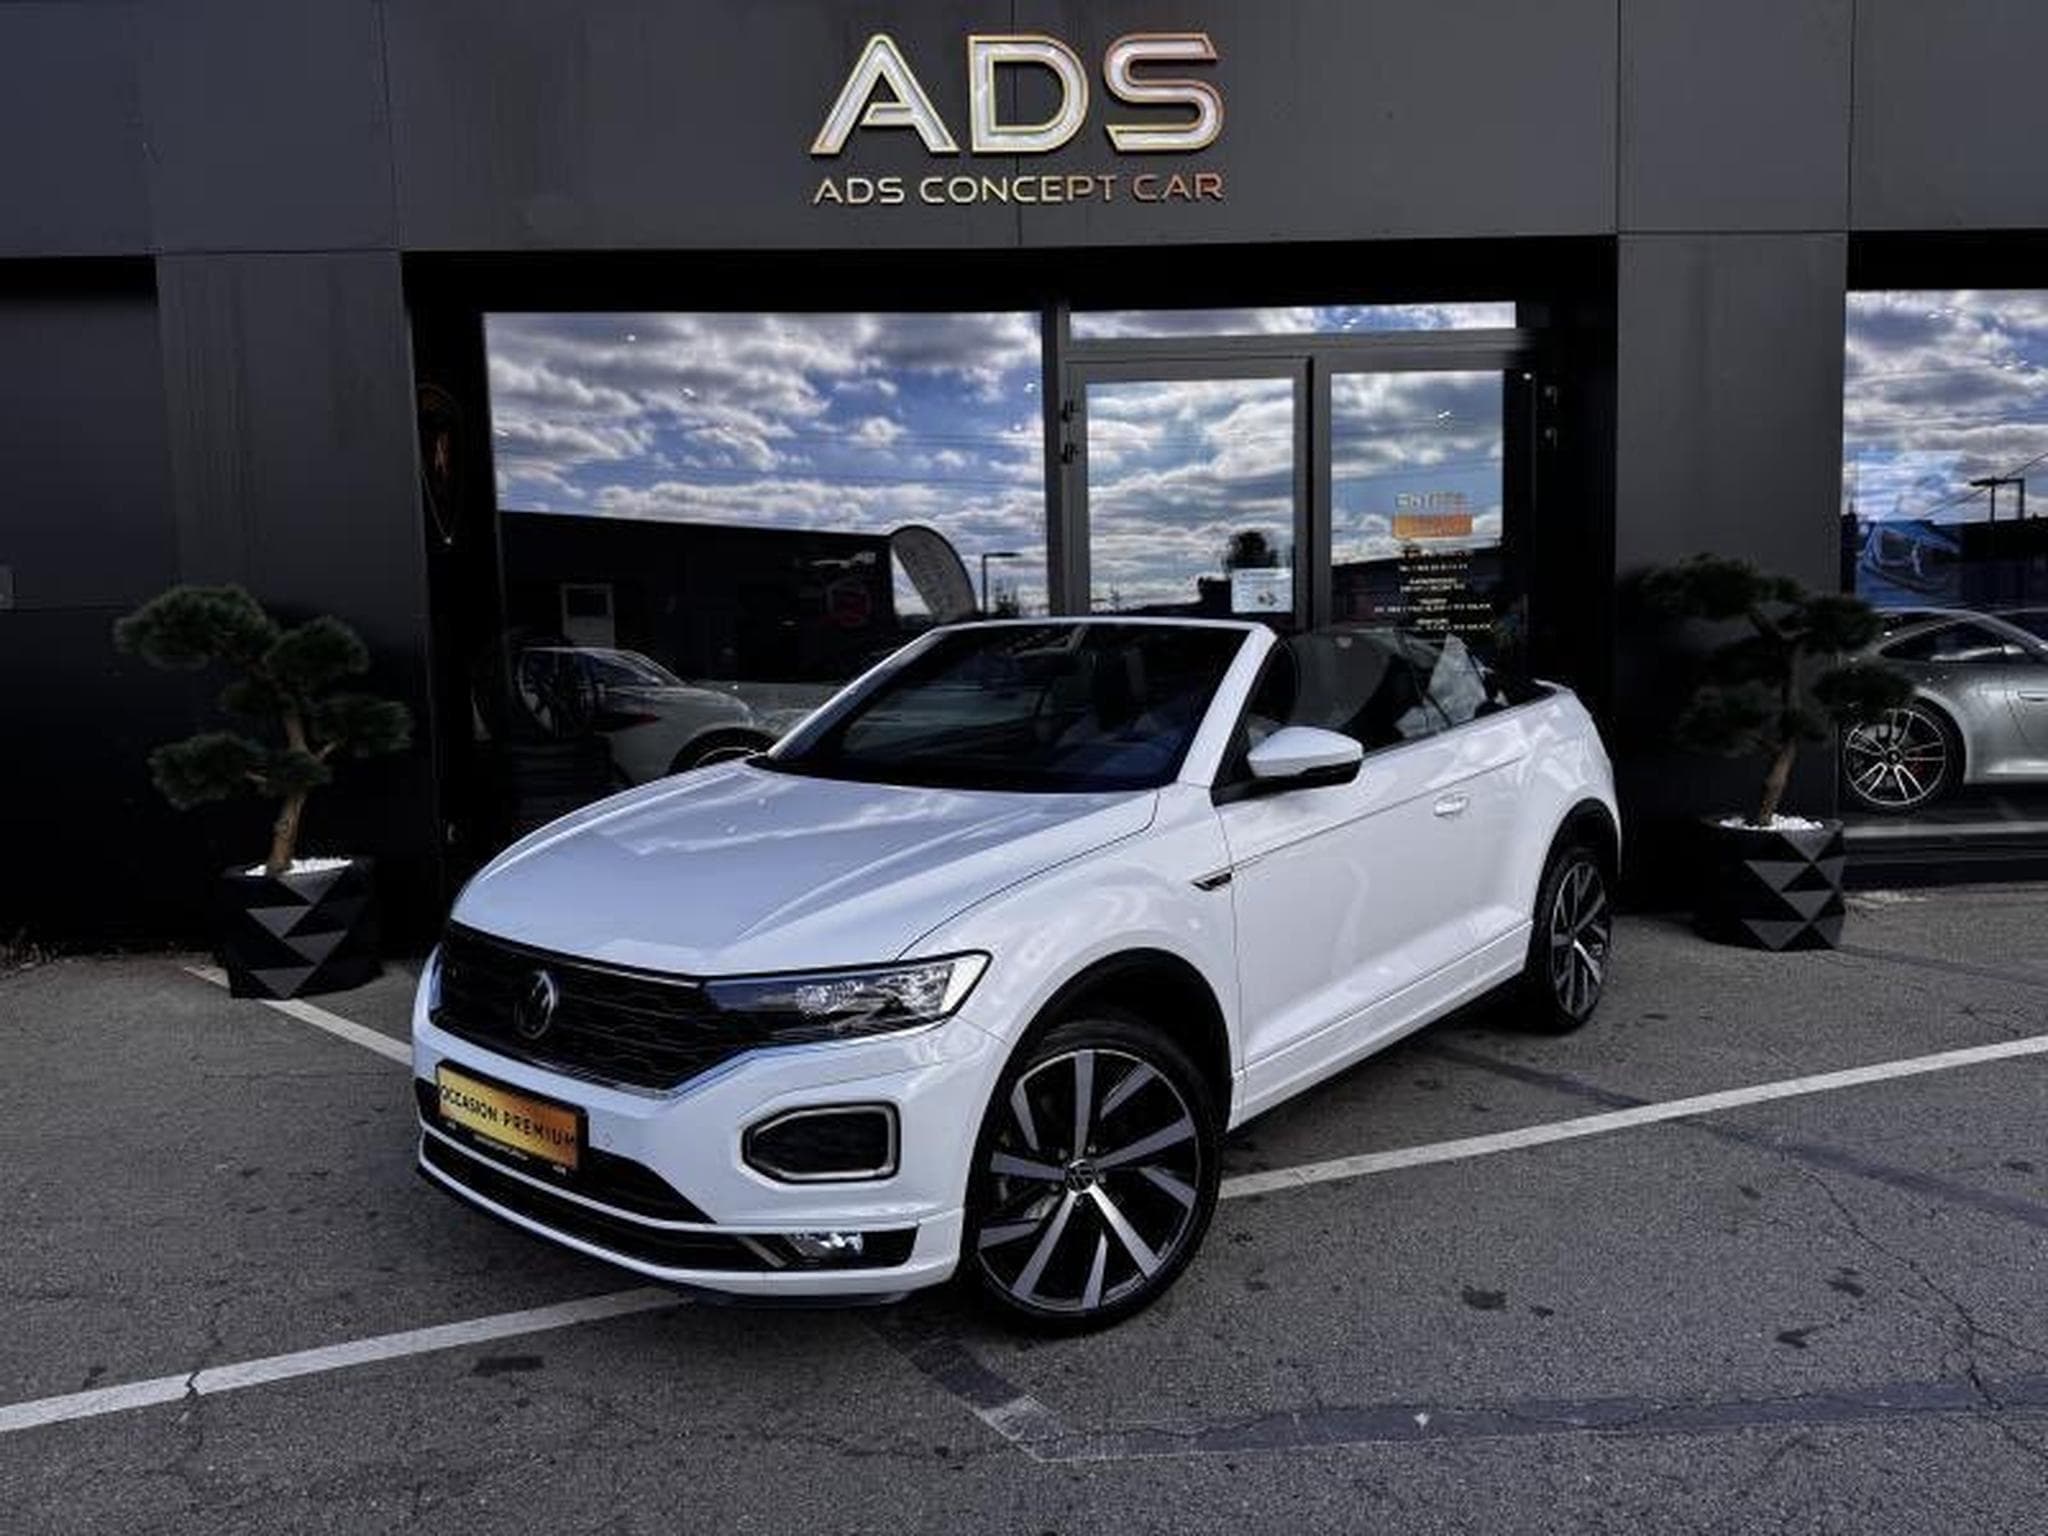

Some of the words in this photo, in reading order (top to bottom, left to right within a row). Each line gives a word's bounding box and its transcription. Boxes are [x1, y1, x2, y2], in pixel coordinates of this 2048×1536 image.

[810, 33, 1225, 153] ADS
[813, 177, 905, 205] ADS
[919, 174, 1116, 204] CONCEPT
[1133, 172, 1225, 202] CAR
[440, 1085, 498, 1122] OCCASION
[503, 1111, 576, 1146] PREMIUM
